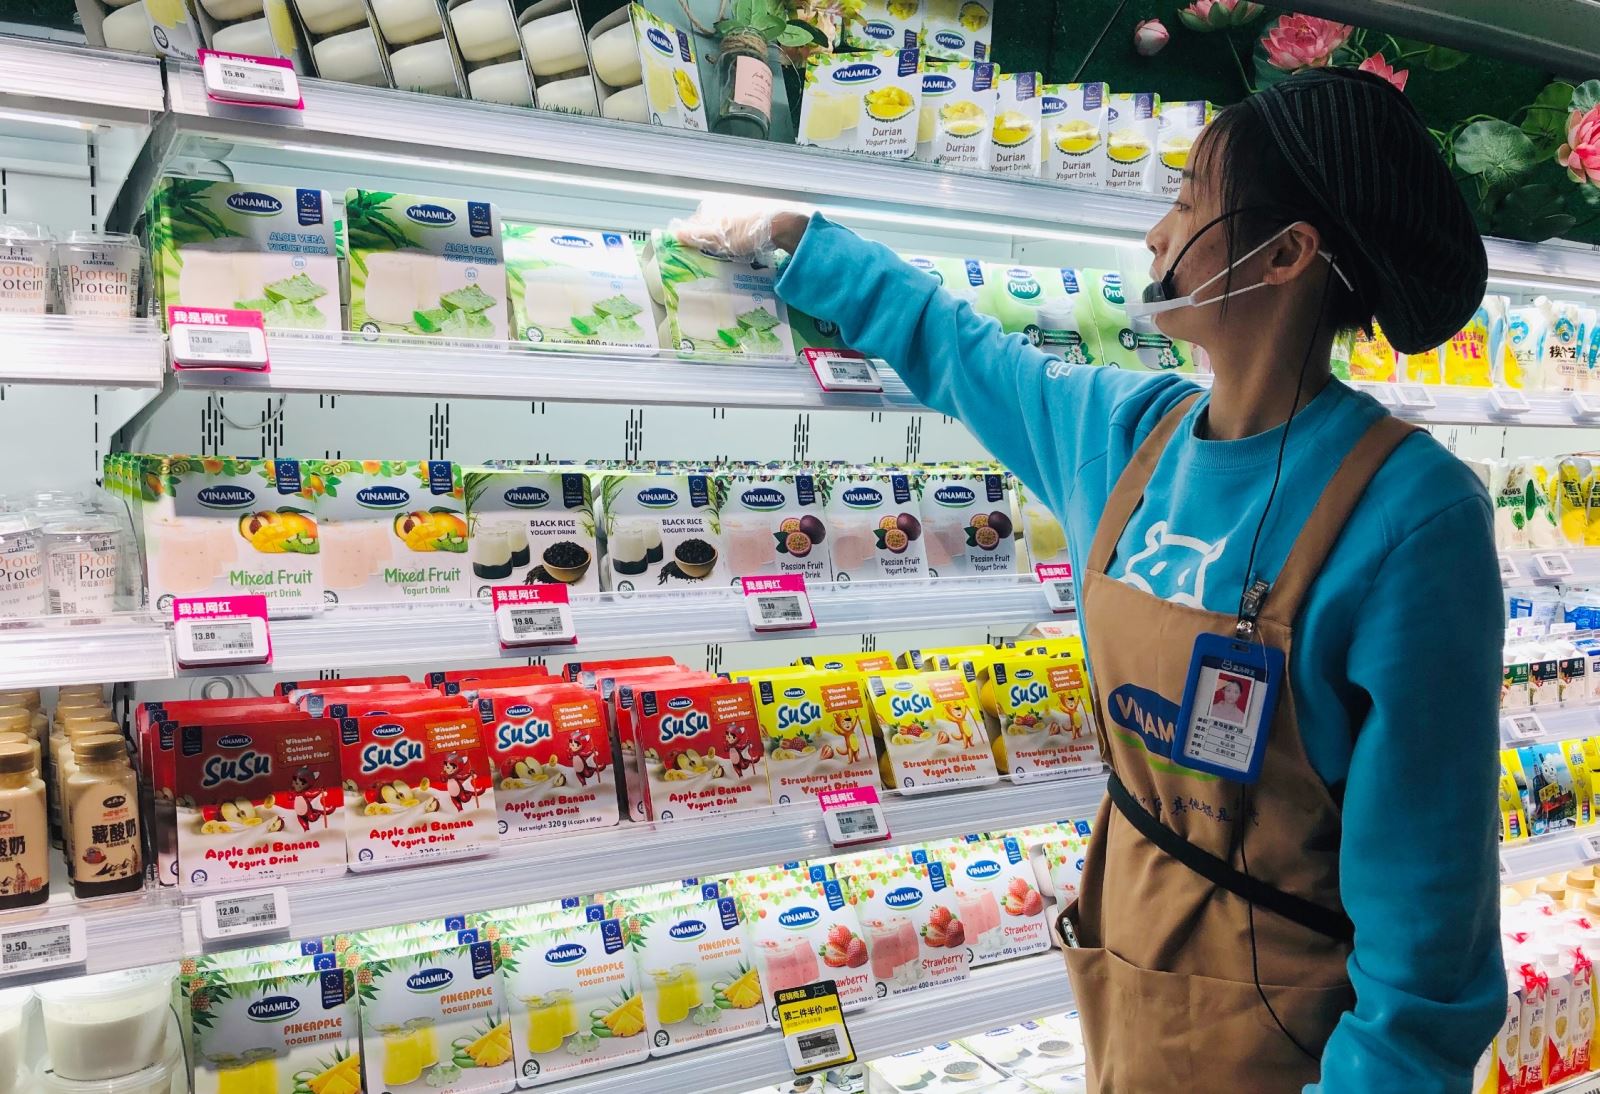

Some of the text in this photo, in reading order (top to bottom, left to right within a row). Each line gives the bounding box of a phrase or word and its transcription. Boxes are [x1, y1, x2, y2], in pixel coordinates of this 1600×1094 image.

[648, 30, 672, 52] VINAMILK
[835, 69, 878, 78] VINAMILK
[922, 80, 953, 88] NAMILK
[872, 127, 902, 136] Durian
[865, 139, 888, 148] Yogurt
[946, 143, 975, 152] Durian
[997, 153, 1025, 162] Durian
[1063, 161, 1090, 170] Durian
[1057, 172, 1078, 180] Yogurt
[1112, 169, 1139, 177] Durian
[231, 198, 280, 210] VINAMILK
[410, 208, 452, 221] VINAMILK
[270, 233, 325, 244] ALOE VERA
[552, 237, 592, 248] VINAMILK
[445, 243, 494, 255] ALOE VERA
[70, 265, 128, 282] Protein
[72, 278, 127, 294] Protein
[1010, 282, 1037, 294] Proby
[174, 311, 228, 324] 我是网红
[202, 490, 251, 501] VINAMILK
[361, 492, 406, 501] VINAMILK
[508, 492, 547, 501] VINAMILK
[744, 494, 782, 502] VINAMILK
[845, 493, 880, 502] VINAMILK
[938, 492, 973, 500] VINAMILK
[781, 562, 806, 570] Passion
[881, 557, 920, 566] Passion Fruit
[230, 570, 312, 584] Mixed Fruit
[384, 568, 460, 583] Mixed Fruit
[402, 585, 450, 596] Yogurt Drink
[746, 581, 781, 590] 我是网红
[497, 590, 540, 600] 我是网红
[178, 602, 231, 613] 我是网红
[194, 632, 215, 640] 13.80
[1011, 683, 1048, 706] SuSu
[892, 695, 931, 716] SuSu
[778, 703, 821, 728] SuSu
[374, 727, 402, 736] VINAMILK
[661, 714, 709, 740] SuSu
[498, 721, 550, 749] SuSu
[220, 737, 250, 746] VINAMILK
[362, 741, 422, 771] SuSu
[1016, 748, 1056, 758] Strawberry
[1069, 744, 1094, 752] Banana
[903, 758, 946, 768] Strawberry
[949, 756, 959, 765] and
[1034, 757, 1060, 766] Yogurt
[204, 753, 271, 786] SuSu
[923, 764, 975, 776] Yogurt Drink
[781, 768, 873, 786] Strawberry and Banana
[670, 793, 696, 802] Apple
[718, 785, 751, 793] Banana
[802, 781, 858, 795] Yogurt Drink
[504, 794, 595, 812] Apple and Banana
[687, 797, 737, 809] Yogurt Drink
[822, 793, 855, 804] 我是网红
[524, 806, 579, 820] Yogurt Drink
[92, 819, 136, 844] 藏酸奶
[370, 821, 473, 840] Apple and Banana
[392, 834, 455, 849] Yogurt Drink
[206, 840, 319, 861] Apple and Banana
[229, 855, 298, 870] Yogurt Drink
[968, 865, 1000, 876] VINAMILK
[887, 892, 921, 903] VINAMILK
[218, 906, 240, 915] 12.80
[782, 910, 817, 923] VINAMILK
[672, 926, 704, 937] VINAMILK
[1004, 923, 1042, 936] Strawberry
[6, 941, 27, 952] 9.50
[698, 937, 739, 952] PINEAPPLE
[548, 947, 585, 961] VINAMILK
[922, 954, 963, 969] Strawberry
[576, 962, 624, 977] PINEAPPLE
[410, 973, 450, 987] VINAMILK
[836, 975, 868, 987] awberry
[440, 987, 492, 1004] PINEAPPLE
[779, 990, 806, 1002] 促销商品
[251, 1001, 297, 1013] VINAMILK
[442, 1000, 492, 1014] YOGURT DRINK
[784, 1006, 822, 1021] 第二件半价
[284, 1017, 342, 1034] PINEAPPLE
[285, 1030, 342, 1046] YOGURT DRINK
